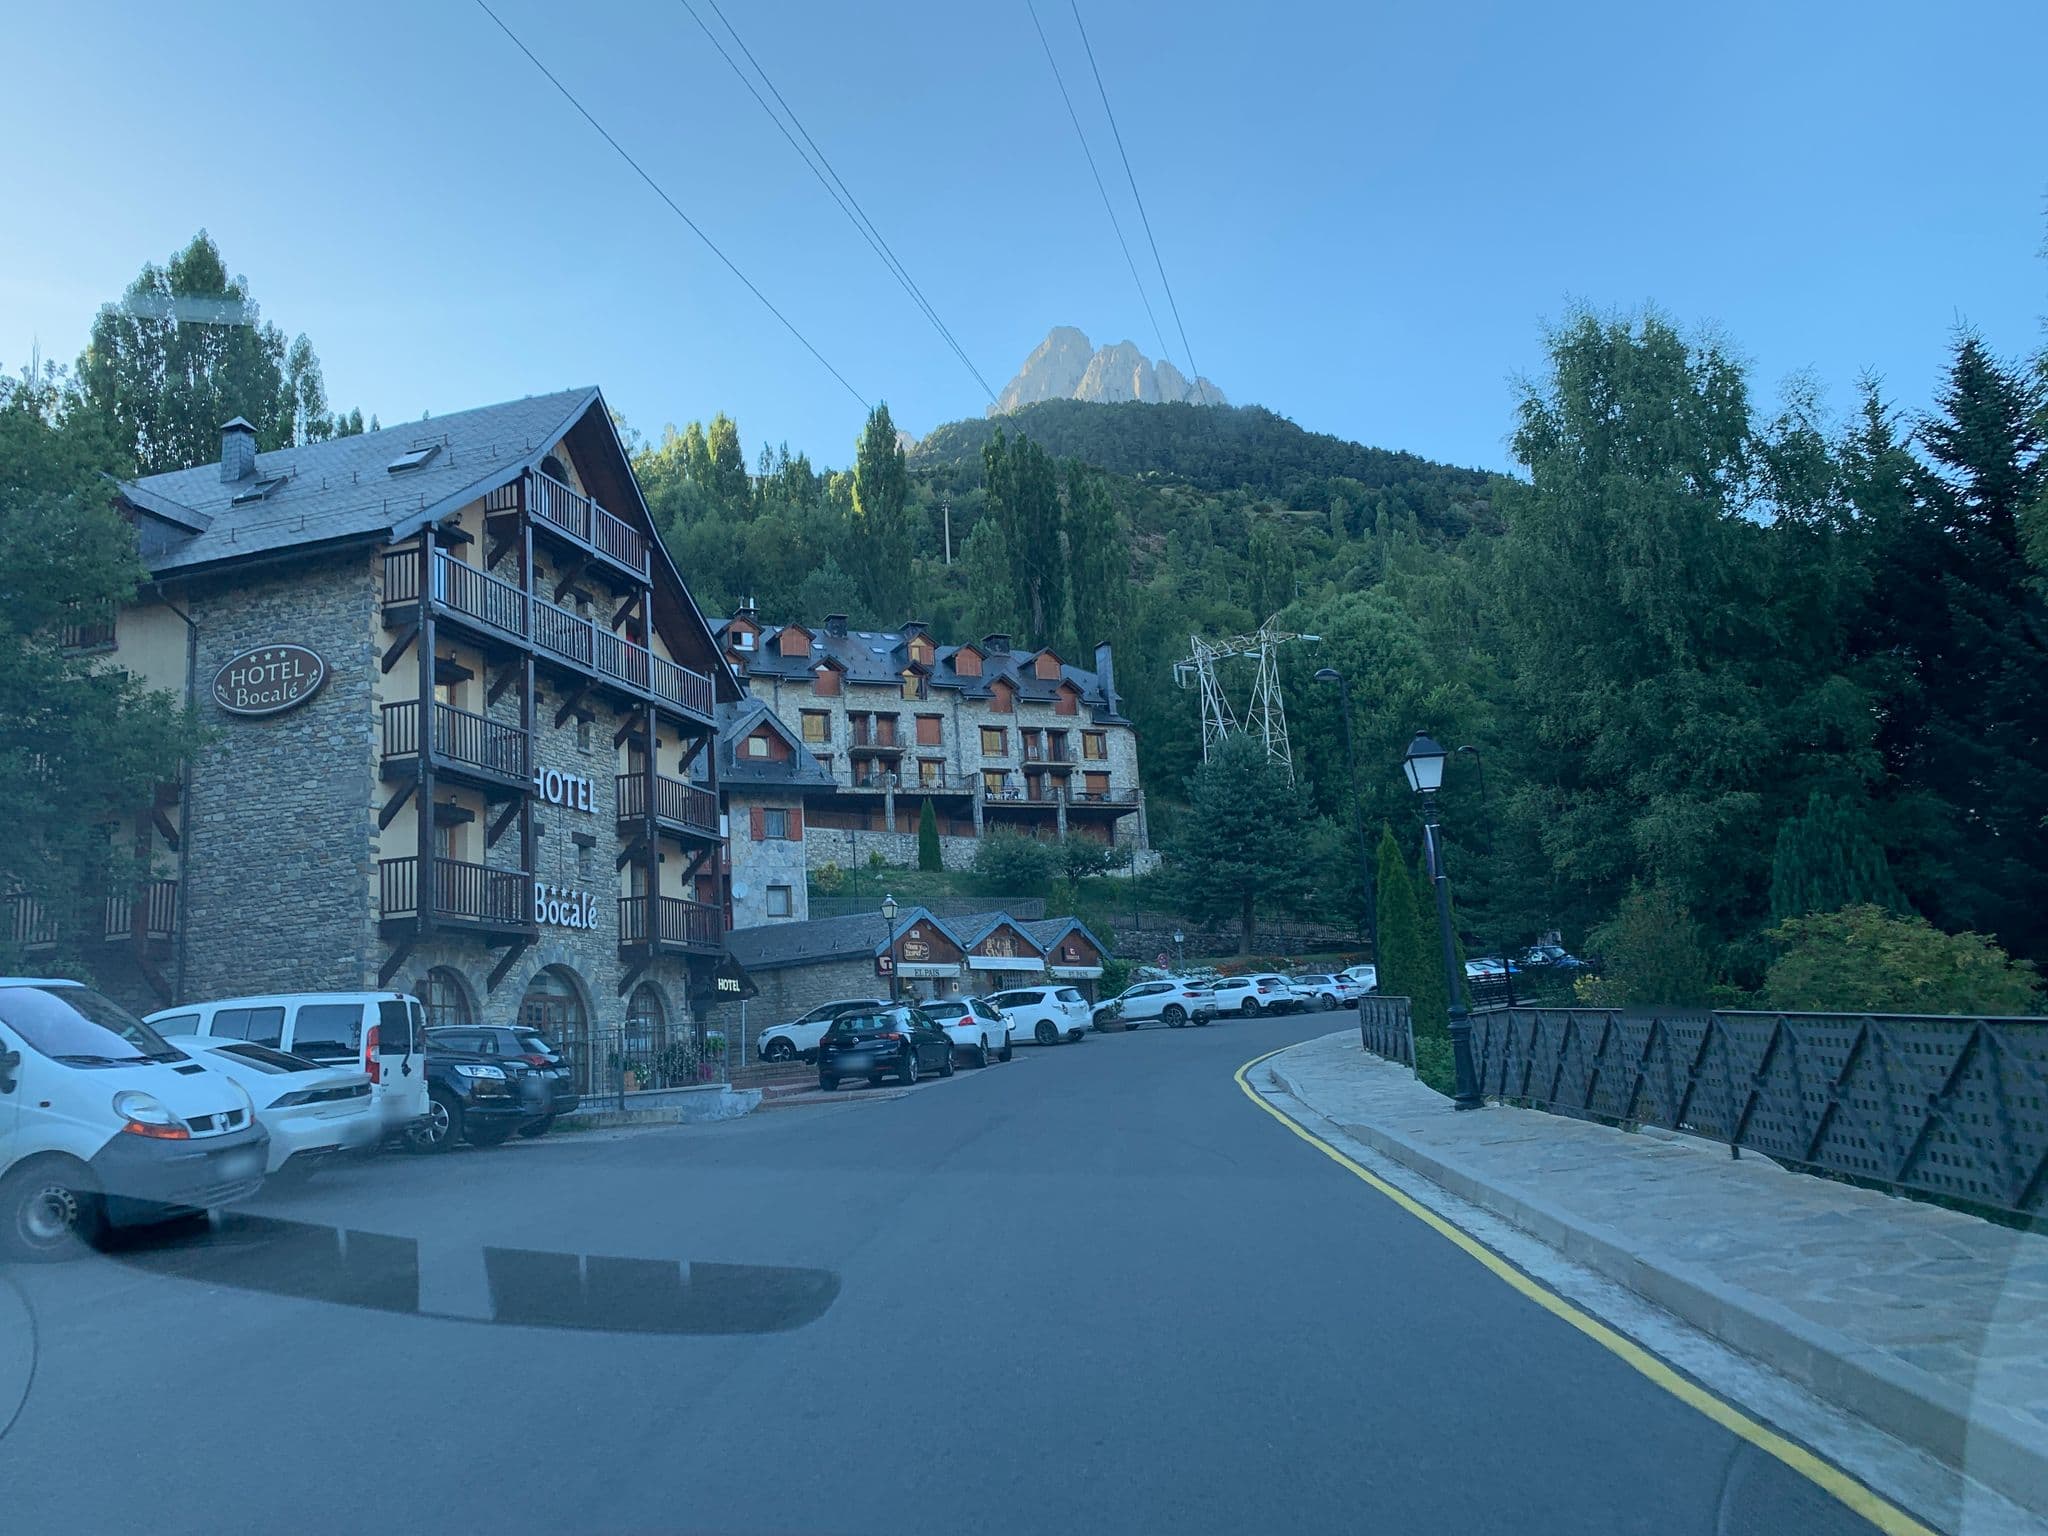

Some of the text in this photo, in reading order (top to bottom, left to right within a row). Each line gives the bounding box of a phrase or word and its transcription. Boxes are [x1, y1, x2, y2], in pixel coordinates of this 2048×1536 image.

[230, 658, 305, 688] HOTEL
[236, 681, 299, 707] Bocalé
[533, 766, 600, 814] HOTEL
[534, 882, 599, 930] Bocalé
[717, 977, 741, 992] HOTEL
[914, 968, 924, 977] EL
